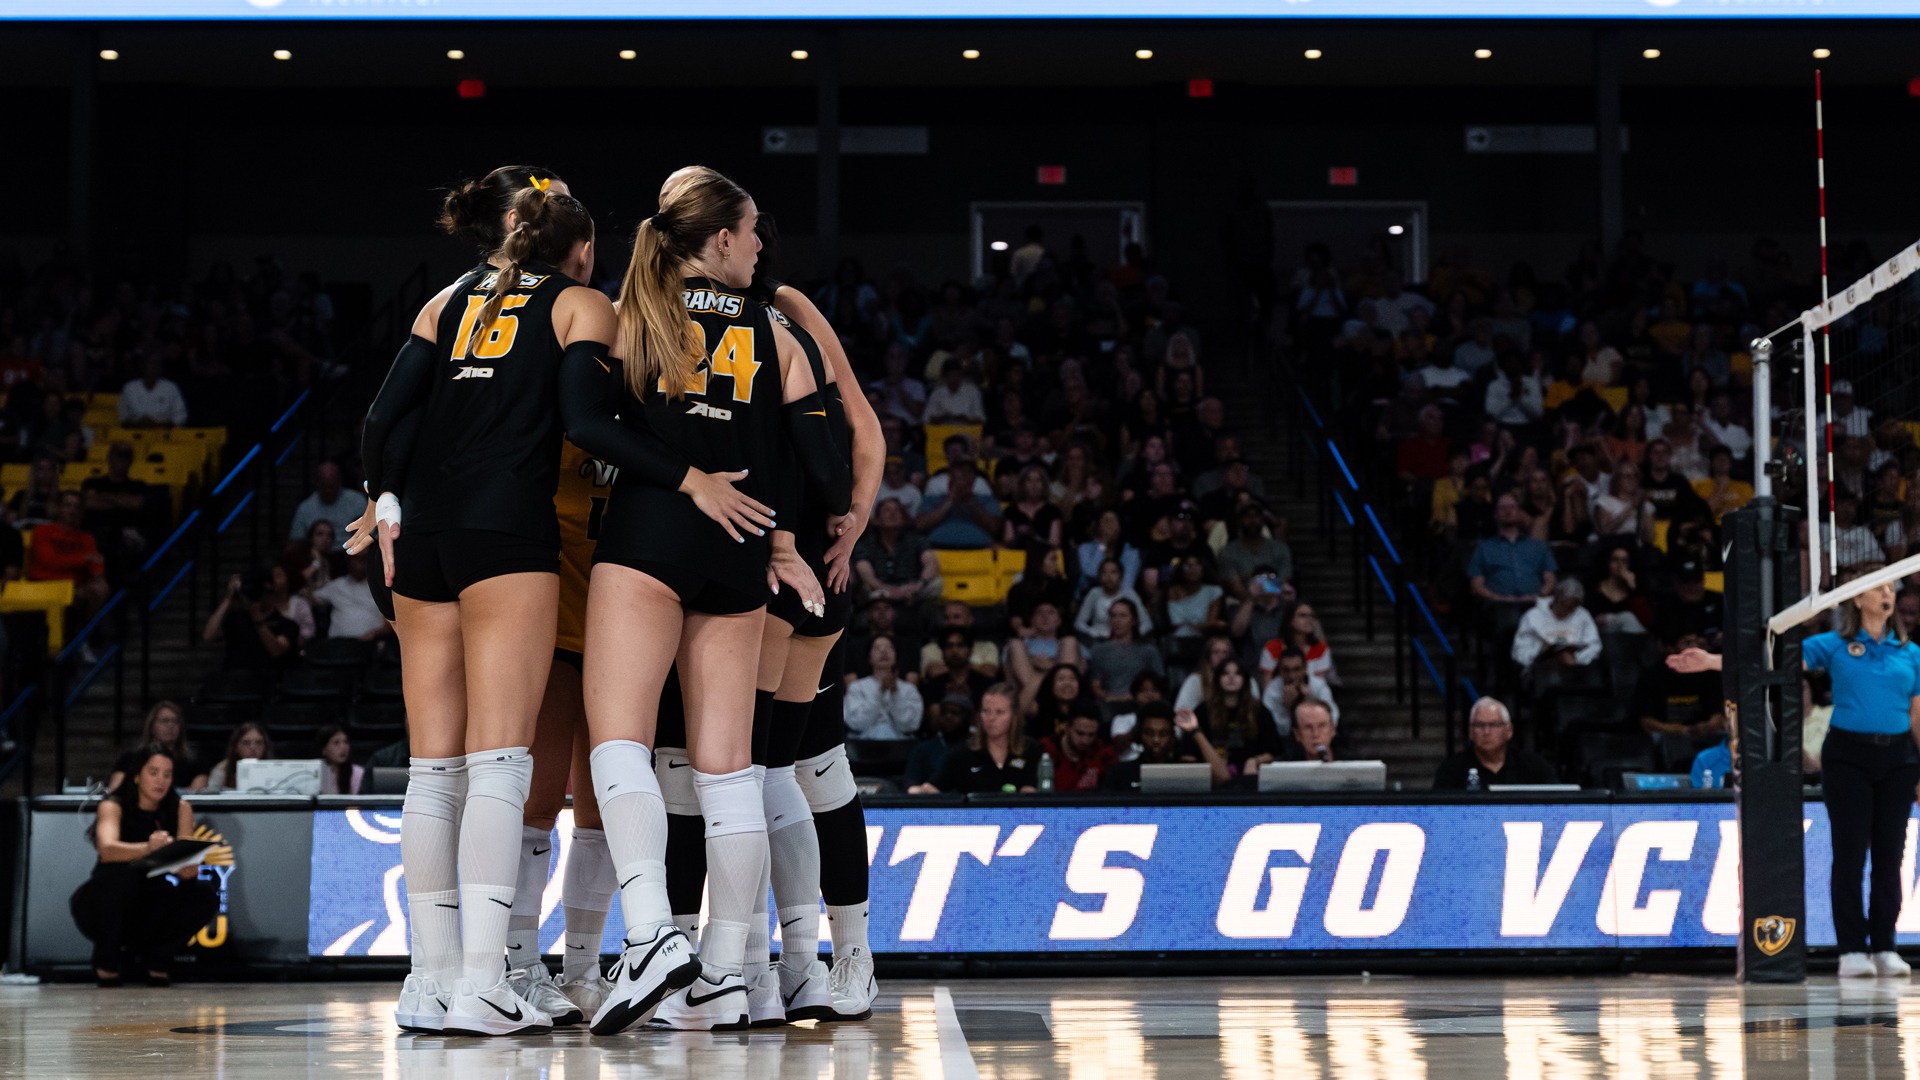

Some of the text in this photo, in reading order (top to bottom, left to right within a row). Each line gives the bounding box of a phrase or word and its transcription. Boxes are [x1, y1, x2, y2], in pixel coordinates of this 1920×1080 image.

[450, 294, 533, 361] 16
[452, 365, 495, 380] A10
[685, 400, 733, 421] A10
[868, 824, 1159, 941] T'S
[1215, 822, 1427, 939] GO
